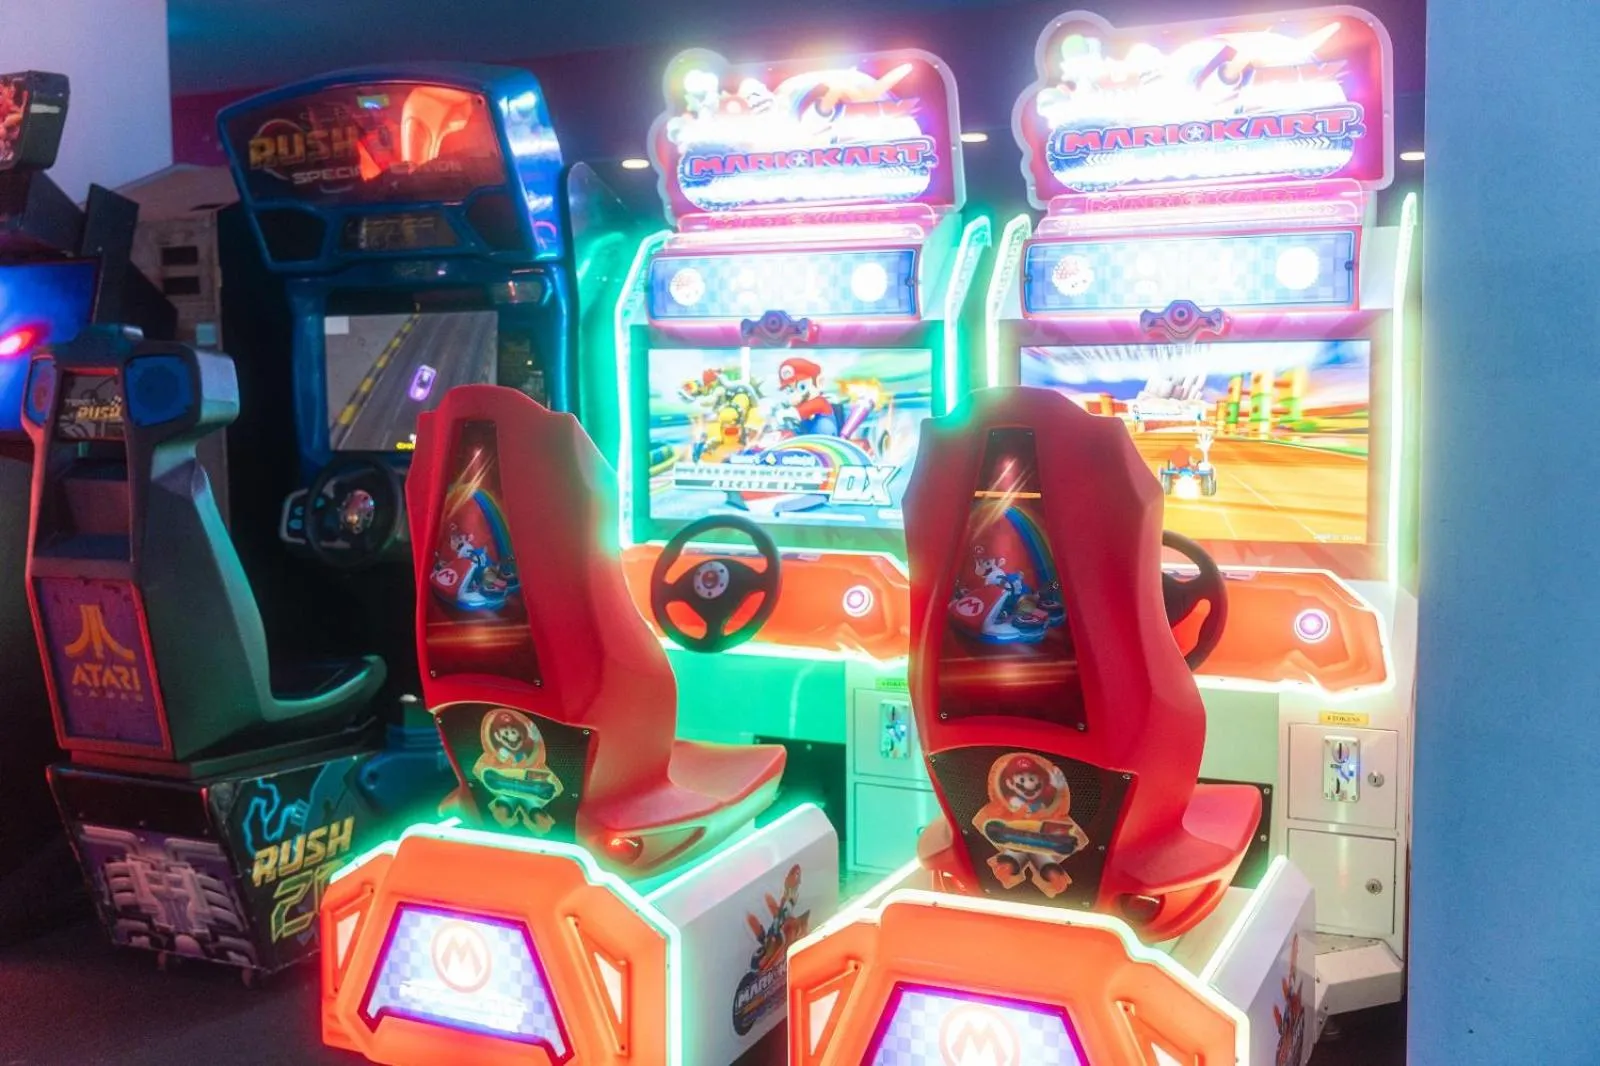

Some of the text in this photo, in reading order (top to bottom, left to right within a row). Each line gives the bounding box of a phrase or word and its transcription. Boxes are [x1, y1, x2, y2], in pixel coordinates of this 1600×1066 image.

[249, 124, 360, 167] RUSH
[291, 166, 363, 184] SPECI
[832, 464, 902, 505] DX
[71, 663, 141, 692] ATARI
[252, 815, 354, 888] RUSH
